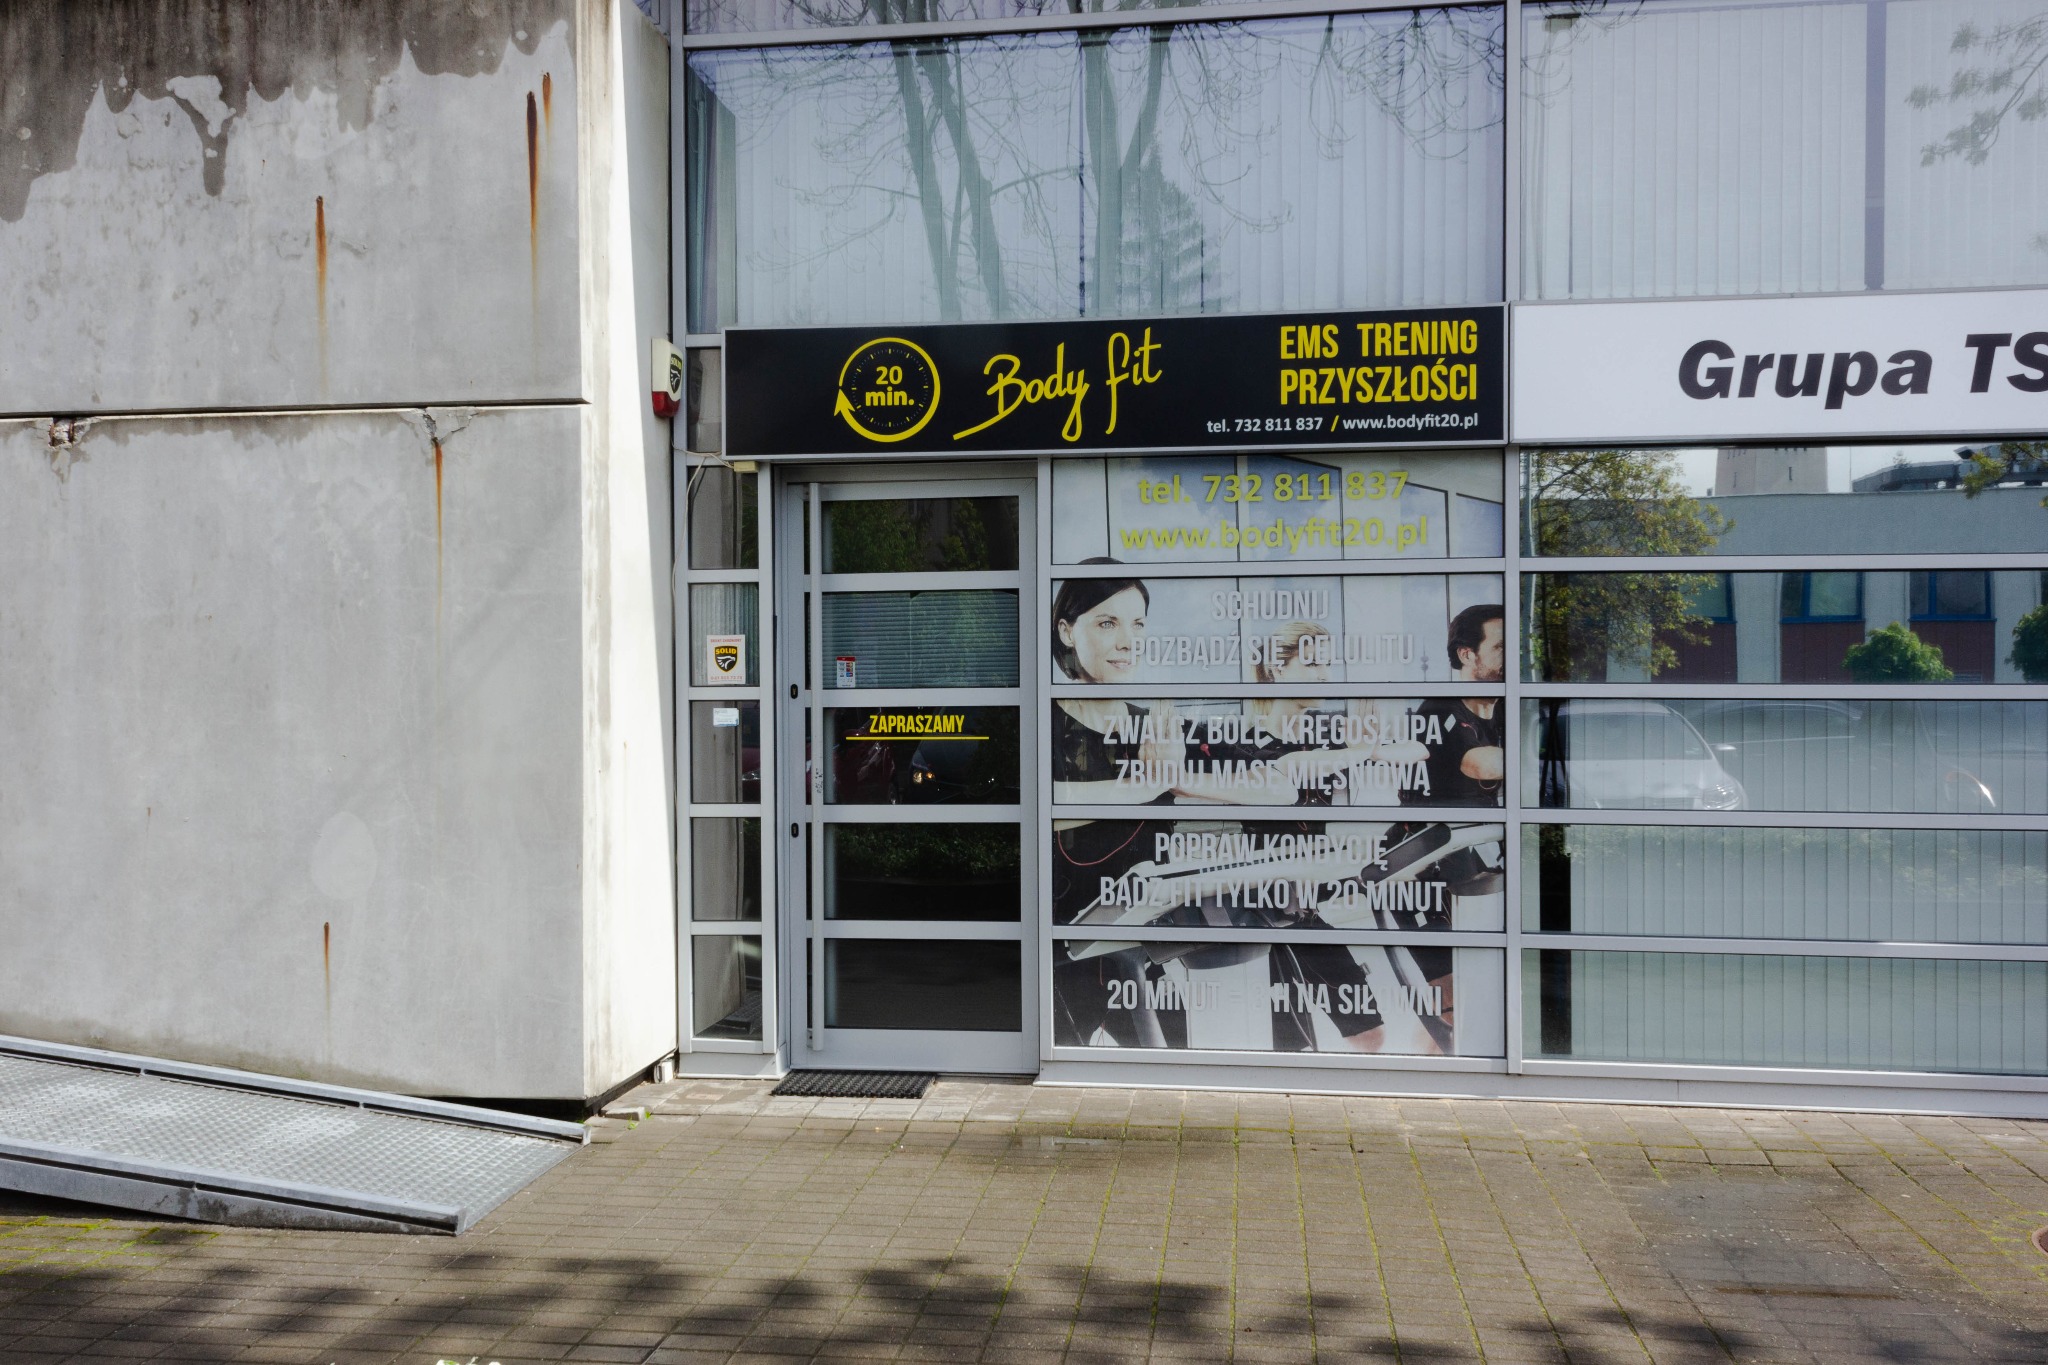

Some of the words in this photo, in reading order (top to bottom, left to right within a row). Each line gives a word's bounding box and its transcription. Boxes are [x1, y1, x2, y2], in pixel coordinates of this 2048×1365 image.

[1280, 324, 1339, 360] EMS
[1357, 319, 1478, 357] TRENING
[875, 365, 903, 385] 20
[953, 342, 1089, 442] Body
[1105, 327, 1163, 435] fit
[1280, 358, 1478, 405] PRZYSZŁOŚCI
[1678, 339, 1933, 410] Grupa
[865, 386, 915, 407] min.
[1207, 419, 1231, 434] tel.
[1234, 418, 1261, 432] 732
[1264, 417, 1291, 432] 811
[1296, 416, 1323, 431] 837
[1342, 413, 1479, 432] www.bodyfit20.pl
[1138, 475, 1191, 505] tel.
[1203, 473, 1263, 503] 732
[1274, 473, 1333, 502] 811
[1347, 470, 1410, 501] 837
[1120, 516, 1428, 554] www.bodyfit20.pl
[1212, 589, 1329, 621] SCHUDNIJ
[715, 647, 737, 655] SOLID
[1130, 629, 1241, 671] POZBĄDŹ
[1247, 635, 1284, 671] SIĘ
[1298, 634, 1414, 665] CELULITU
[869, 714, 965, 734] ZAPRASZAMY
[1103, 715, 1201, 746] ZWALCZ
[1282, 714, 1443, 751] KRĘGOSŁUPA
[1115, 759, 1204, 790] ZBUDUJ
[1155, 832, 1257, 863] POPRAW
[1264, 833, 1388, 871] KONDYCJĘ
[1170, 878, 1202, 908] FIT
[1215, 878, 1290, 909] TYLKO
[1297, 880, 1320, 910] W
[1328, 880, 1358, 911] 20
[1368, 881, 1447, 912] MINUT
[1107, 979, 1138, 1010] 20
[1145, 980, 1221, 1012] MINUT
[1298, 983, 1332, 1014] NA
[1338, 983, 1442, 1017] SIŁOWNI
